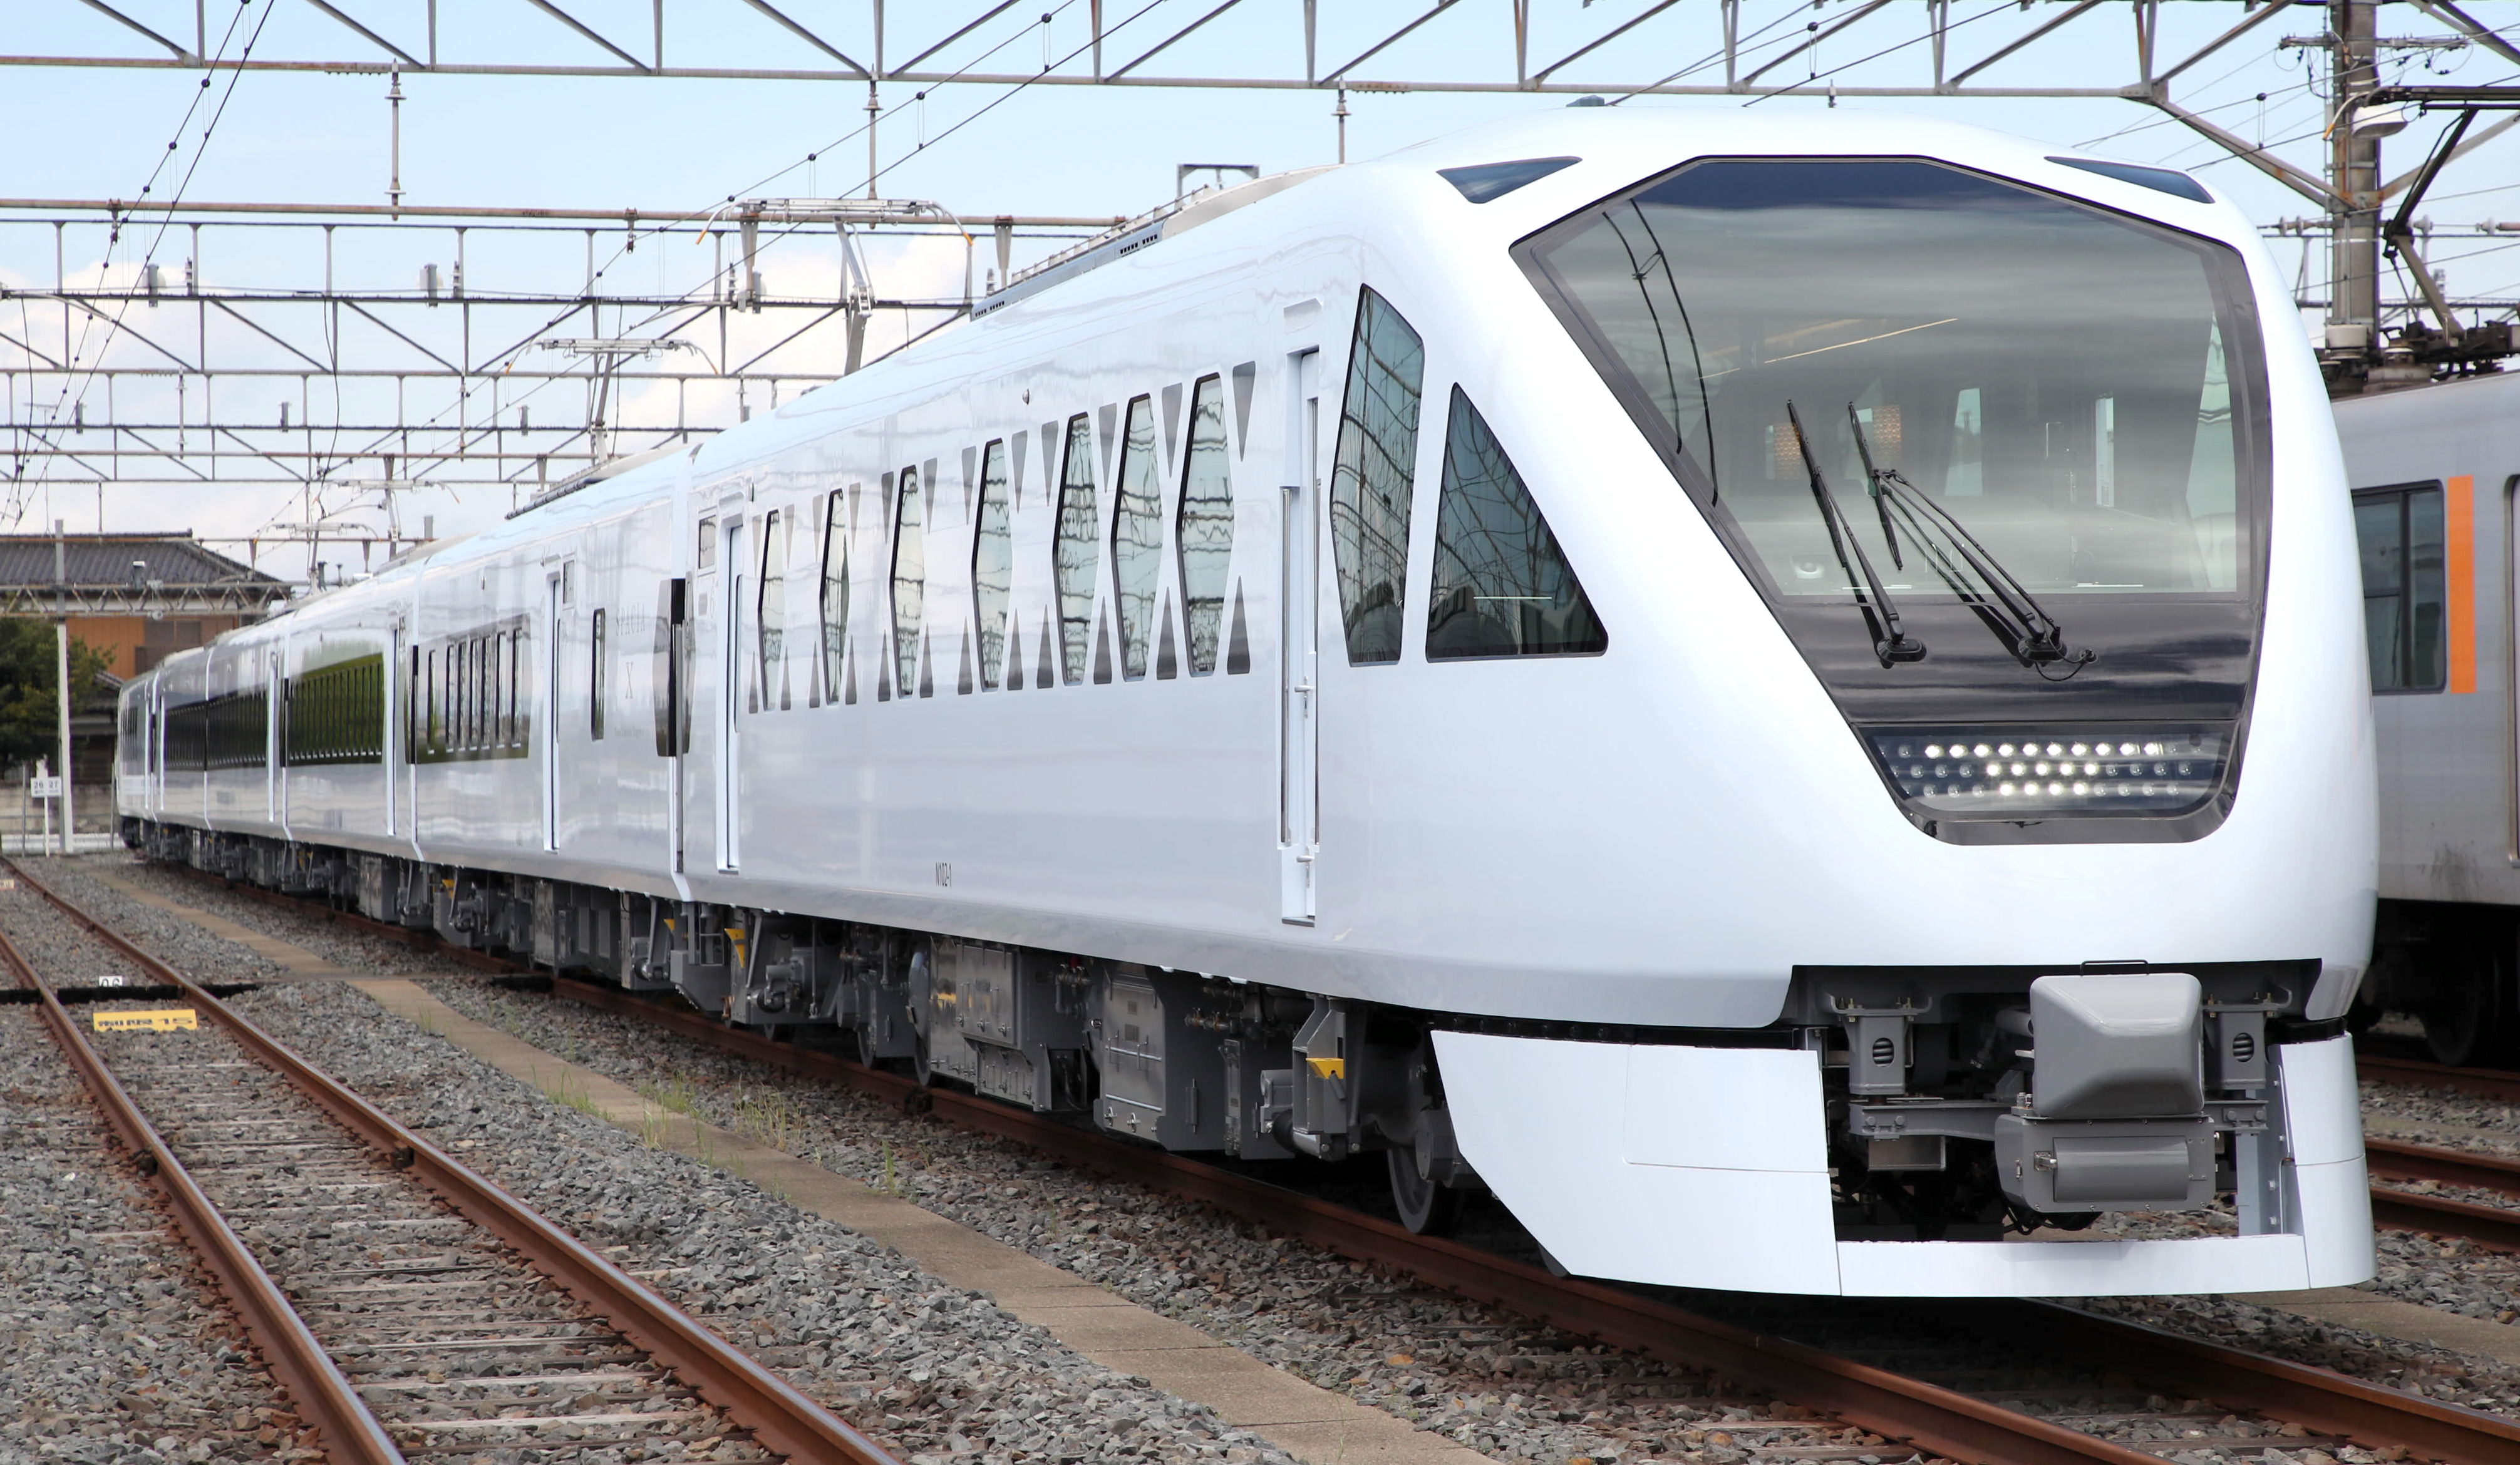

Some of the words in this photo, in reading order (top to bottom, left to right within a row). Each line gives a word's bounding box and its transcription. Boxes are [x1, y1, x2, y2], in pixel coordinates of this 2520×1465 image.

[616, 602, 646, 636] SPACIA
[626, 662, 633, 699] X
[935, 861, 952, 888] N102-1
